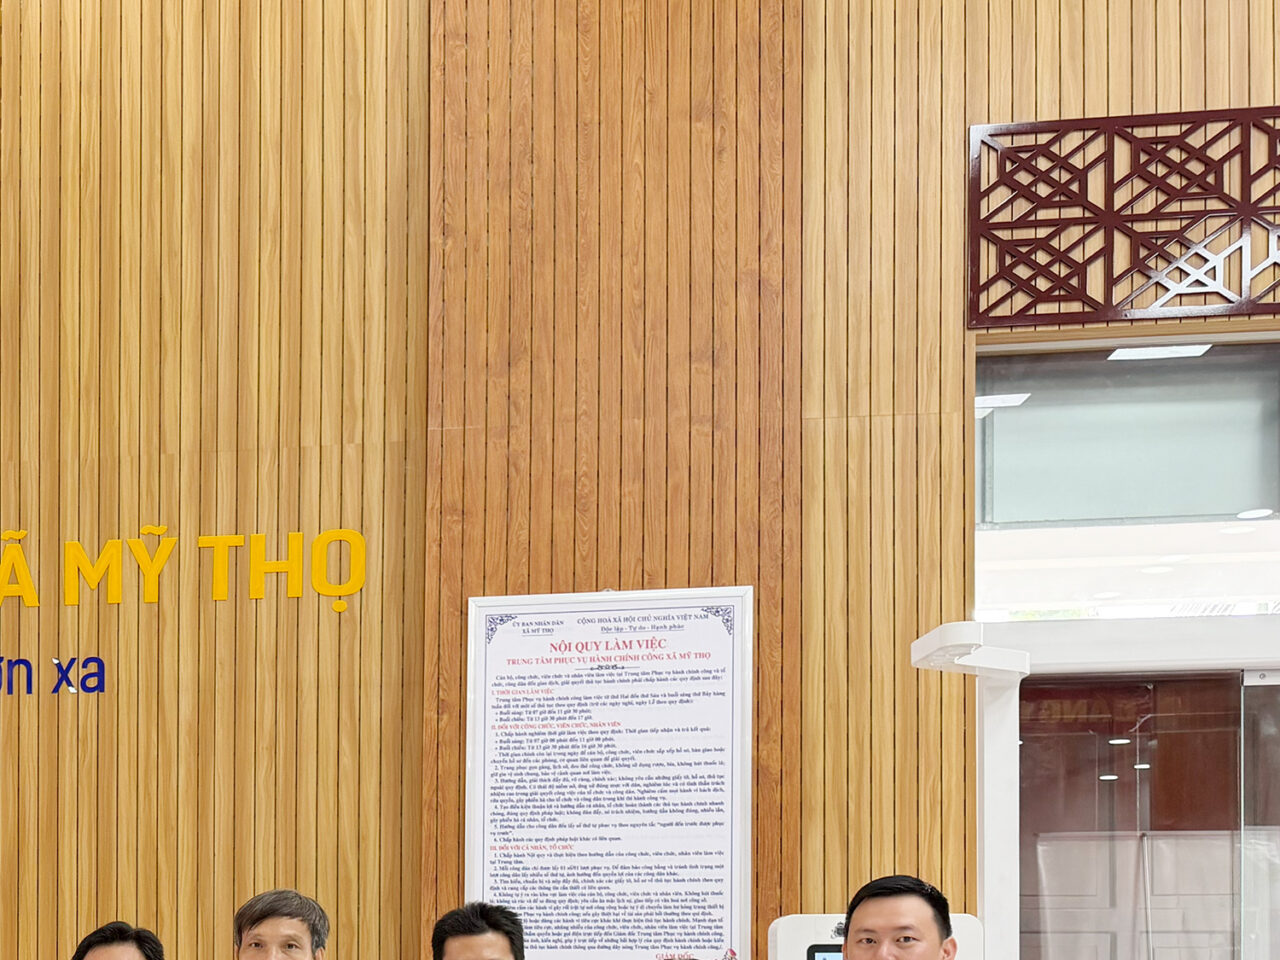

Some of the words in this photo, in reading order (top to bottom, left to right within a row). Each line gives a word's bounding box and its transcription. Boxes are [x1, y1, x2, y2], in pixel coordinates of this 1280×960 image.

[64, 525, 178, 606] MỸ
[199, 529, 366, 612] THỌ
[550, 640, 572, 654] NỘI
[575, 641, 601, 654] QUY
[605, 638, 632, 650] LÀM
[636, 636, 666, 652] VIỆC
[51, 656, 105, 694] xa
